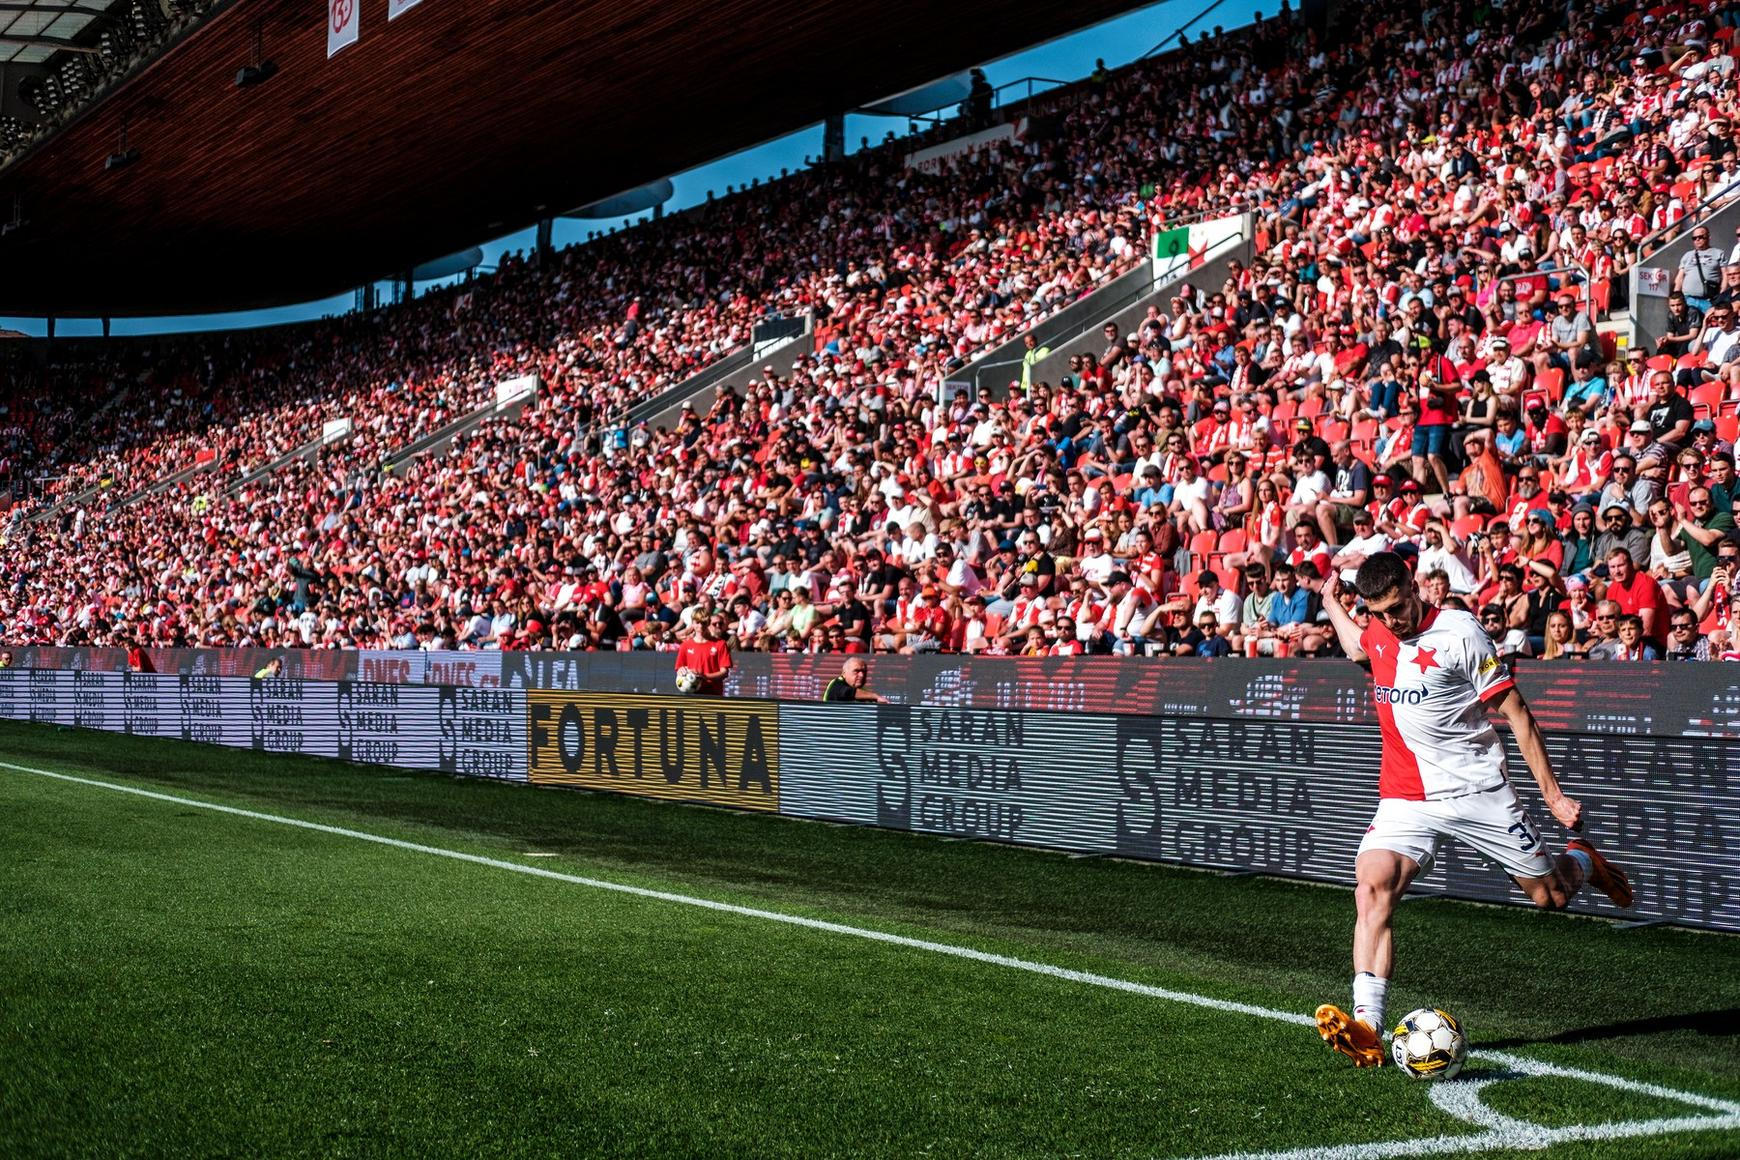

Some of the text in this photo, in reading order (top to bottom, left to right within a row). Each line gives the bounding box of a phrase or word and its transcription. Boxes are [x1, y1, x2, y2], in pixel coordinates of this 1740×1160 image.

[266, 678, 303, 701] SARAN
[357, 684, 398, 707] SARAN
[461, 688, 513, 714] SARAN
[267, 704, 303, 726] MEDIA
[357, 711, 398, 734] MEDIA
[921, 710, 1021, 746] SARAN
[268, 729, 303, 751] GROUP
[461, 717, 513, 743] MEDIA
[1175, 721, 1314, 763] SARAN
[358, 739, 398, 763] GROUP
[530, 702, 772, 795] FORTUNA
[462, 749, 513, 777] GROUP
[921, 752, 1021, 791] MEDIA
[1559, 738, 1726, 792] ARAN
[1175, 768, 1314, 817] MEDIA
[922, 796, 1021, 839] GROUP
[1176, 822, 1314, 873] GROUP
